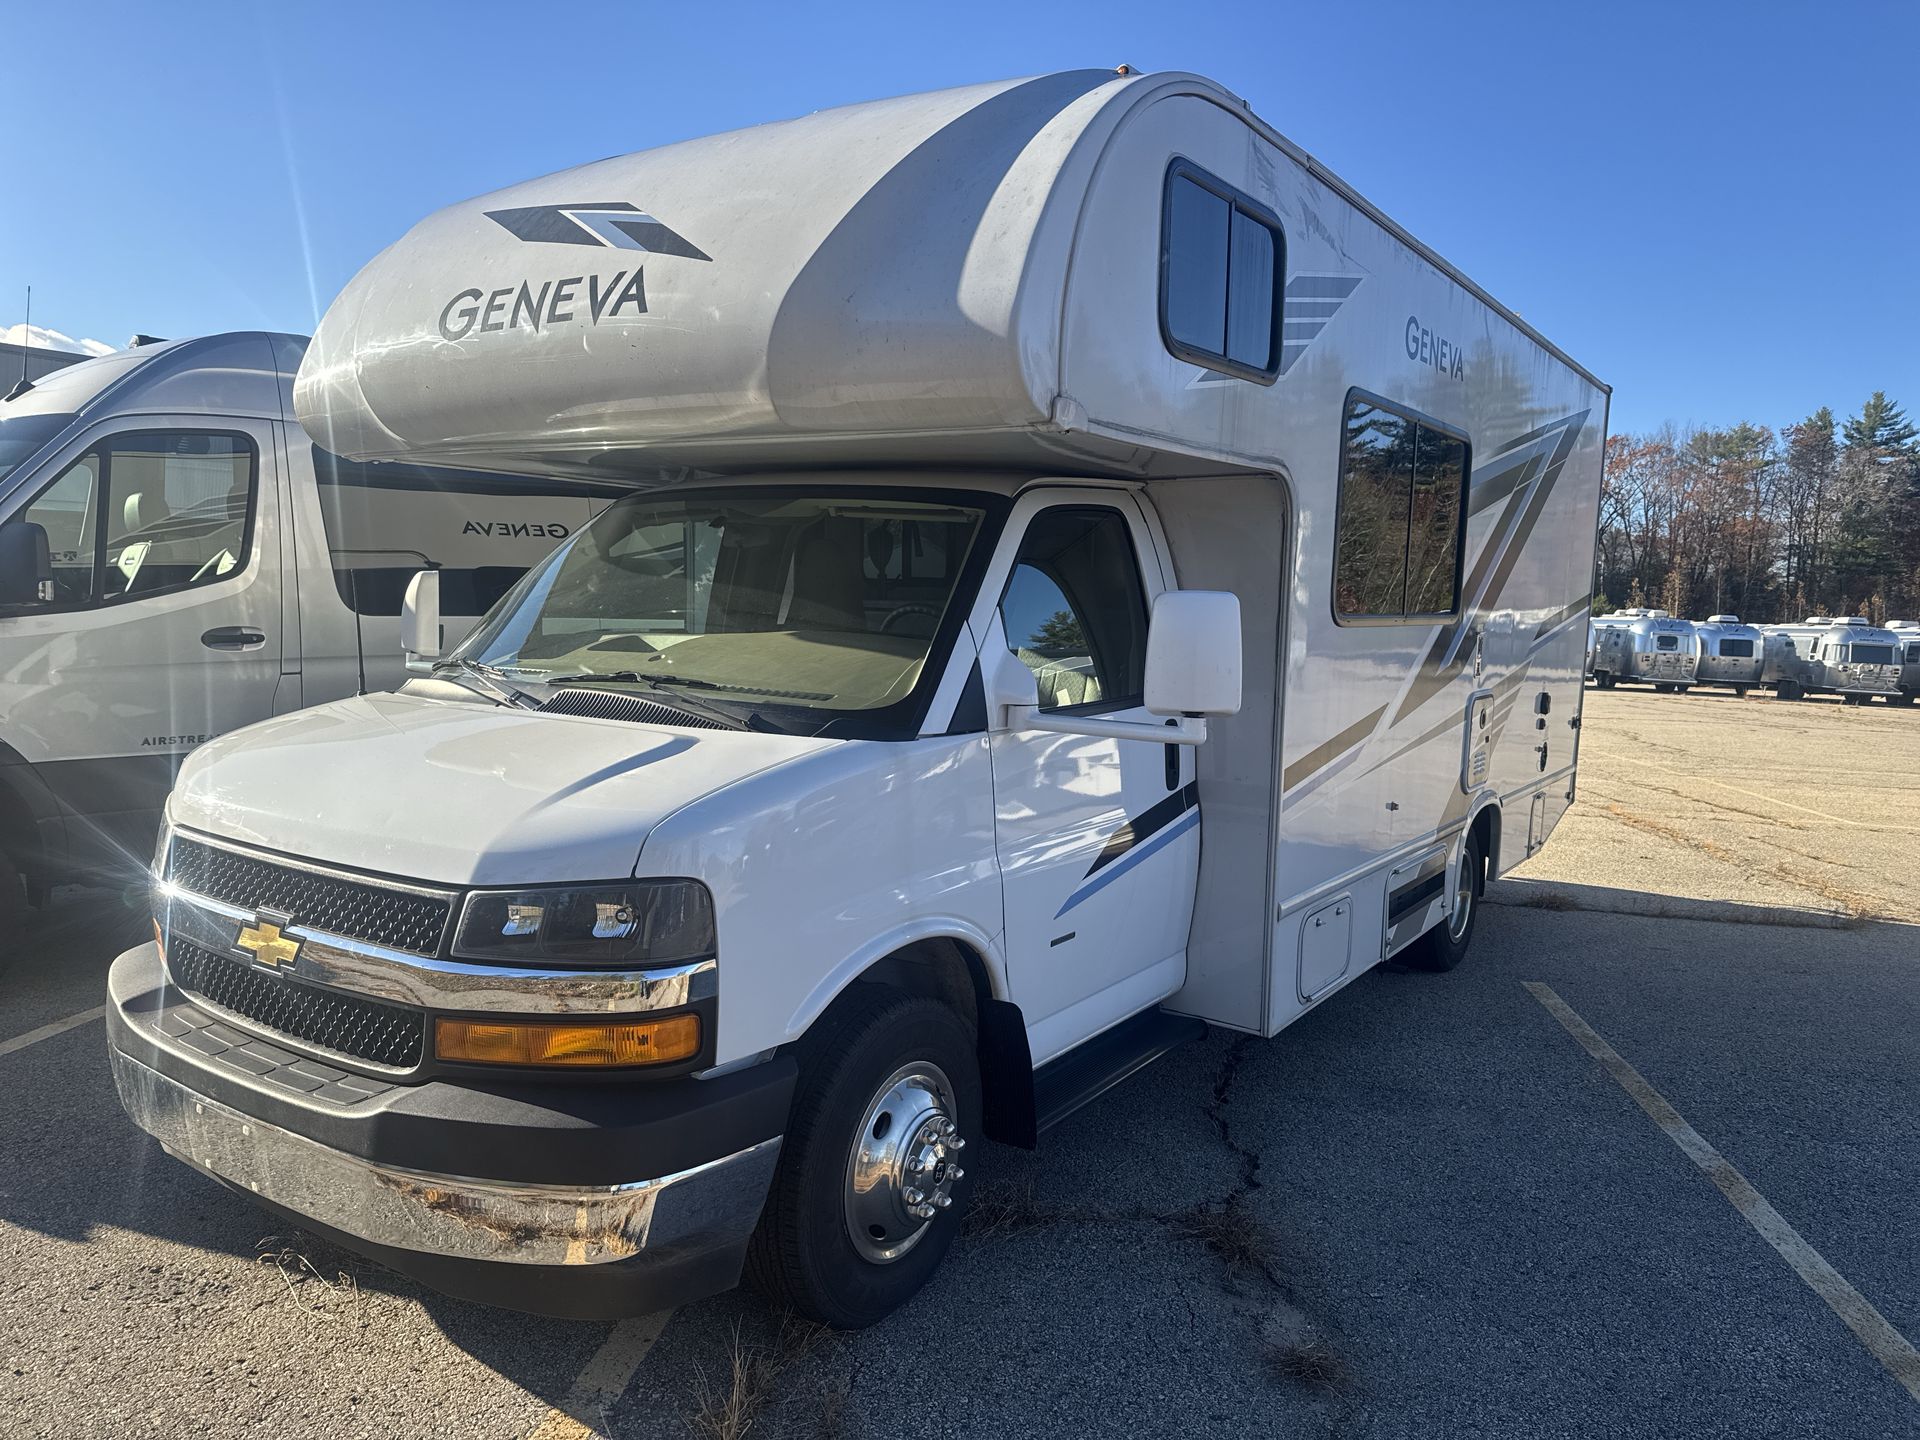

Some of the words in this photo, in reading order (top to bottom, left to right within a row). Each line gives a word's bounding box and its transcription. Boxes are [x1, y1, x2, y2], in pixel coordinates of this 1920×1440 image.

[438, 264, 648, 341] GENEVA
[1405, 315, 1463, 382] GENEVA
[141, 734, 220, 746] AIRSTREA
